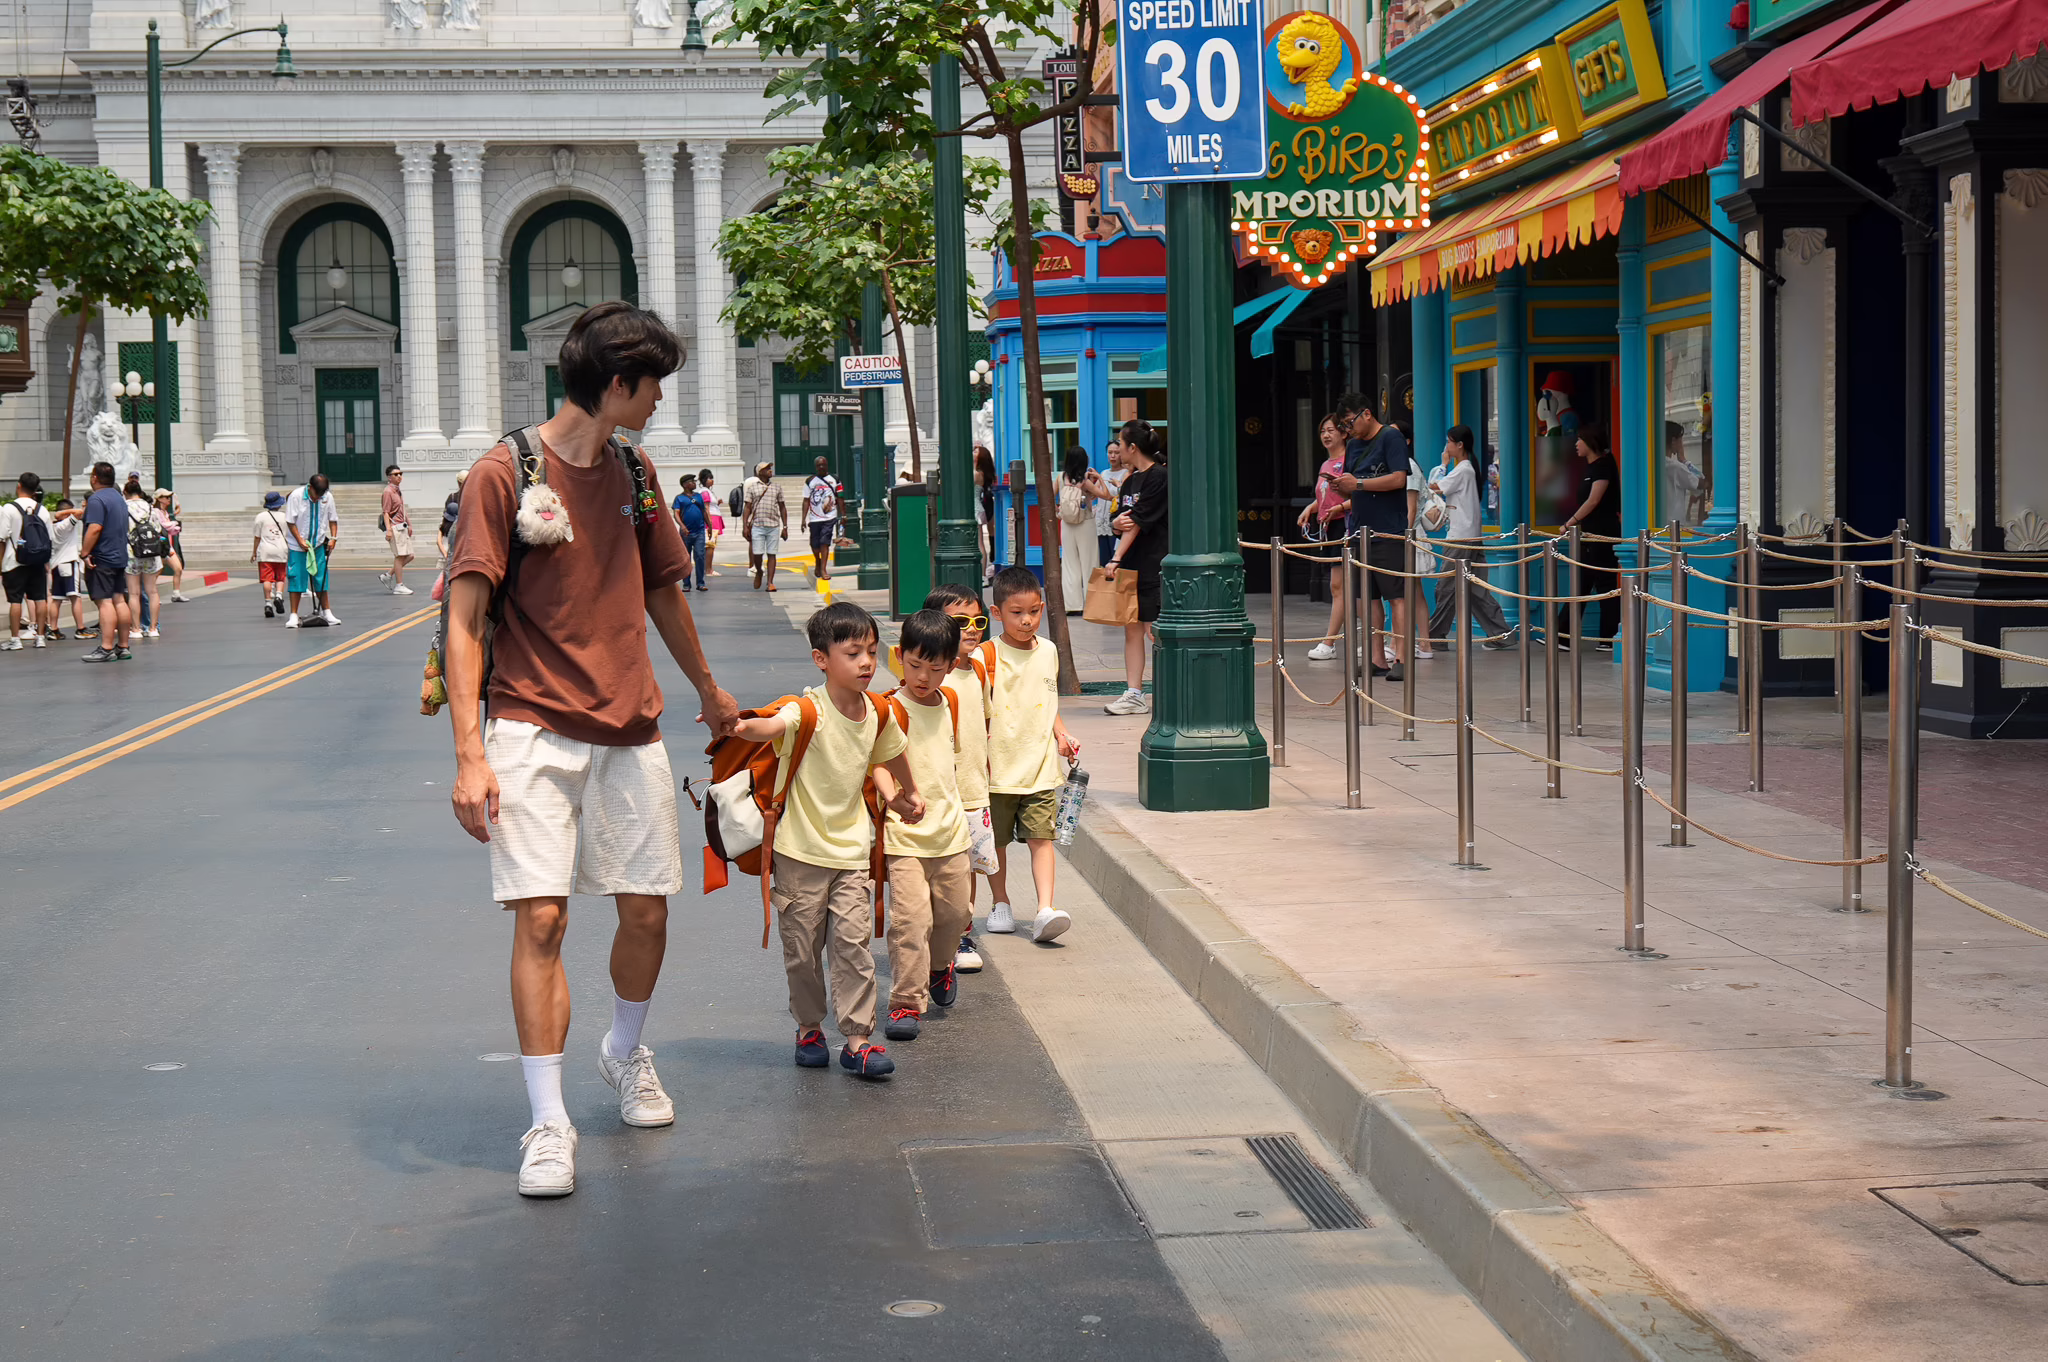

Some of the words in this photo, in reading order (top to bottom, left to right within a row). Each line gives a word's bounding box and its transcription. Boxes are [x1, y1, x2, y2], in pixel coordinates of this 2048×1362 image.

[1129, 0, 1195, 31] SPEED
[1200, 0, 1251, 27] LIMIT
[1053, 63, 1077, 73] LOUI
[1145, 38, 1241, 124] 30
[1575, 39, 1627, 98] GIFTS
[1062, 80, 1080, 169] PZZA
[1436, 83, 1549, 168] EMPORIUM
[1167, 133, 1223, 164] MILES
[1231, 182, 1418, 220] MPORIUM
[1441, 248, 1455, 269] BIG
[1454, 240, 1475, 265] BIRD'S
[1478, 226, 1515, 257] EMPORIUM
[1035, 255, 1072, 272] IZZA
[844, 370, 902, 381] PEDESTRIANS
[845, 356, 902, 369] CAUTION
[839, 396, 861, 404] Restro
